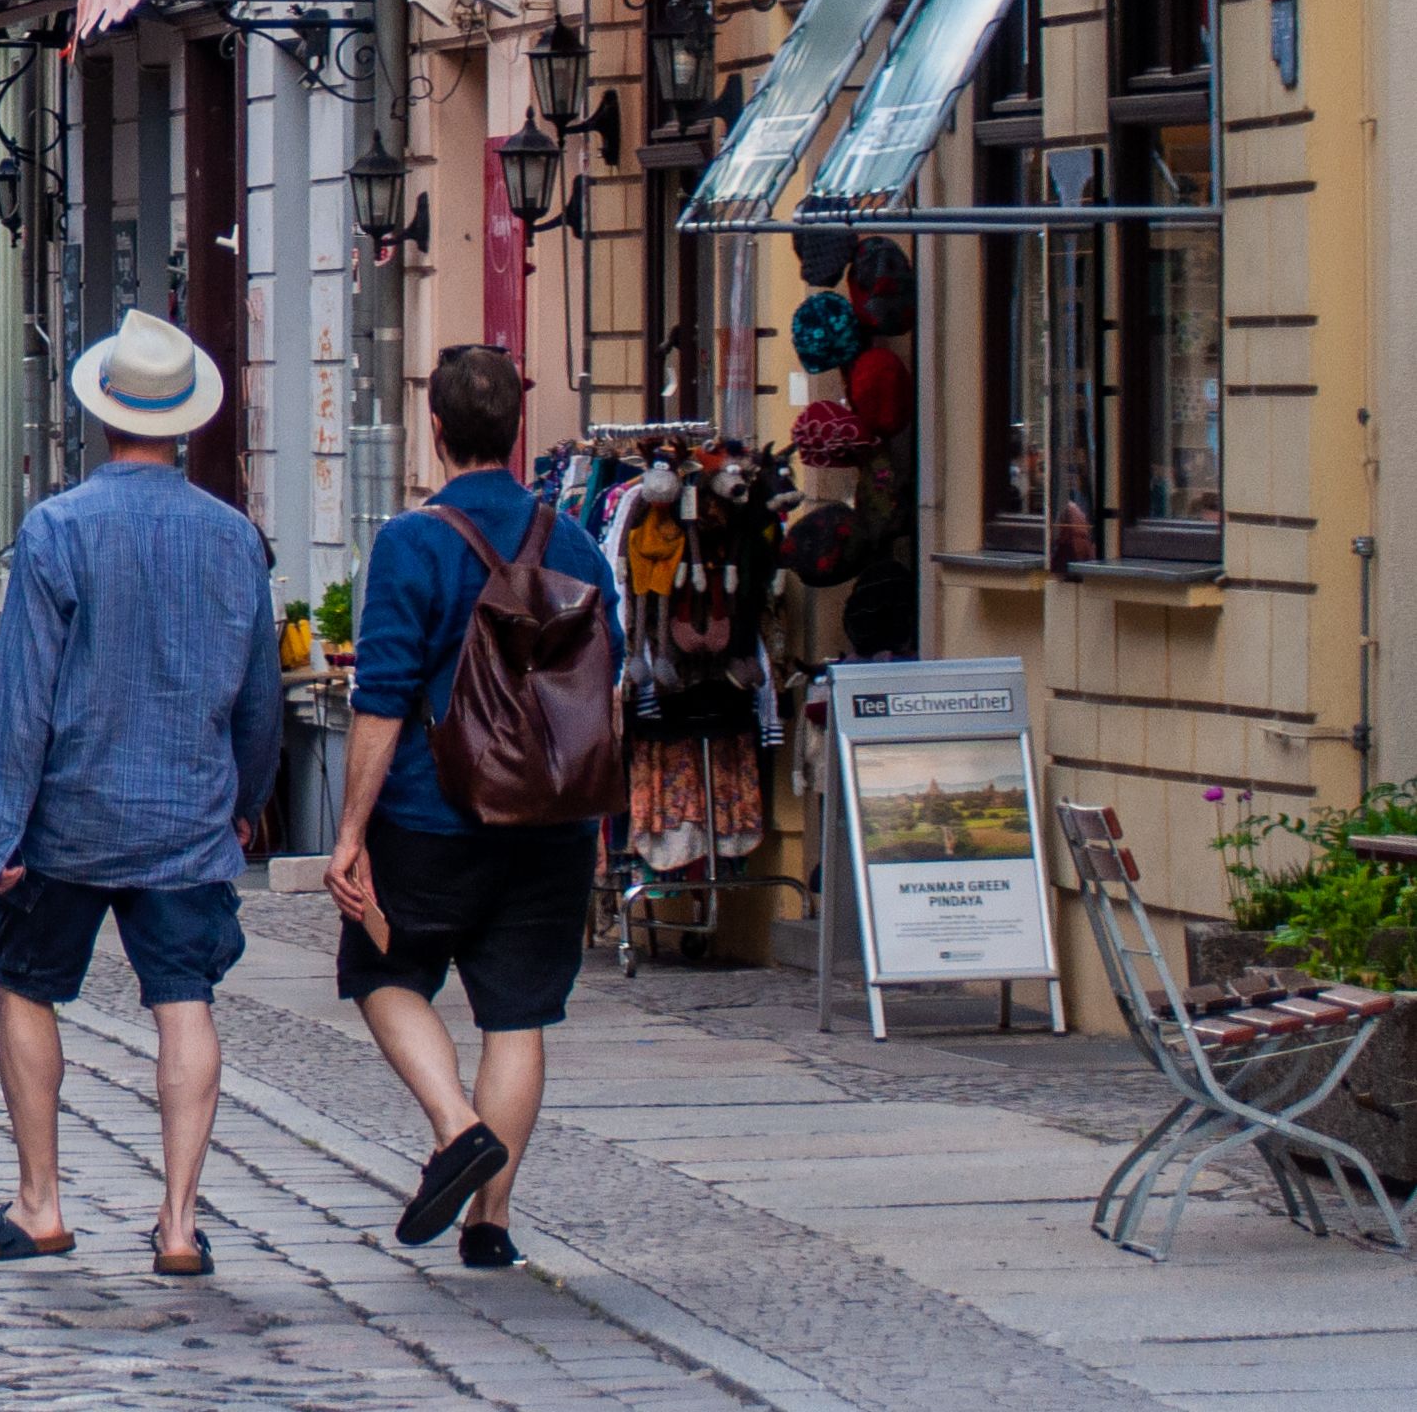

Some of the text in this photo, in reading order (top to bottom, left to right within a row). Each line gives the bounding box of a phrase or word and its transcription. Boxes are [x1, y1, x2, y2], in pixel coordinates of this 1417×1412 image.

[855, 693, 1008, 715] Tee Gschwendner
[899, 879, 1010, 894] MYANMAR GREEN
[929, 895, 984, 907] PINDAYA
